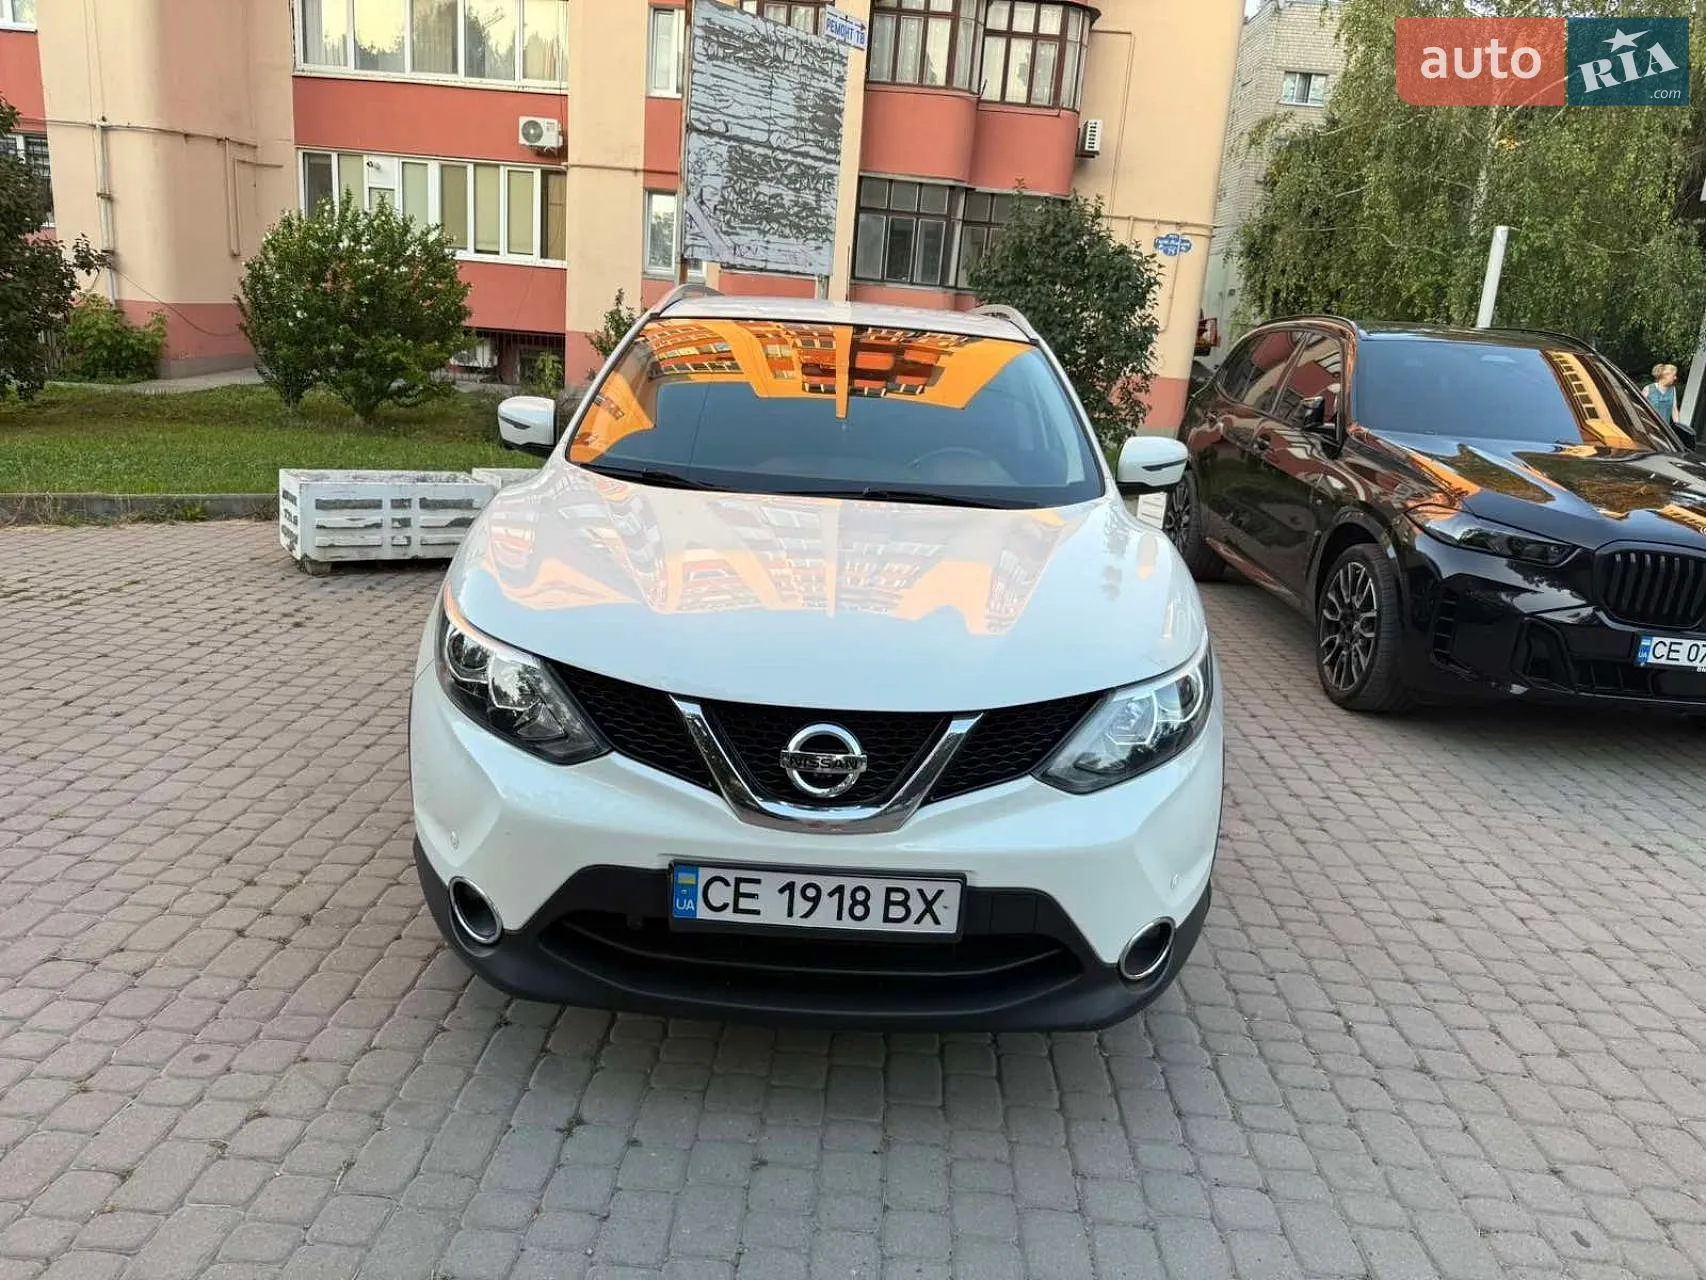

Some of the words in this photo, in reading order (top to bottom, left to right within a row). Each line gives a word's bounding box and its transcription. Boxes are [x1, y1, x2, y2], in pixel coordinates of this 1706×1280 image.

[826, 19, 854, 41] РЕМОНТ
[856, 31, 865, 45] ТВ
[1652, 640, 1683, 662] CE
[789, 757, 859, 769] NISSAN
[676, 898, 696, 911] UA
[702, 875, 762, 916] CE
[778, 880, 871, 922] 1918
[882, 887, 944, 926] BX
